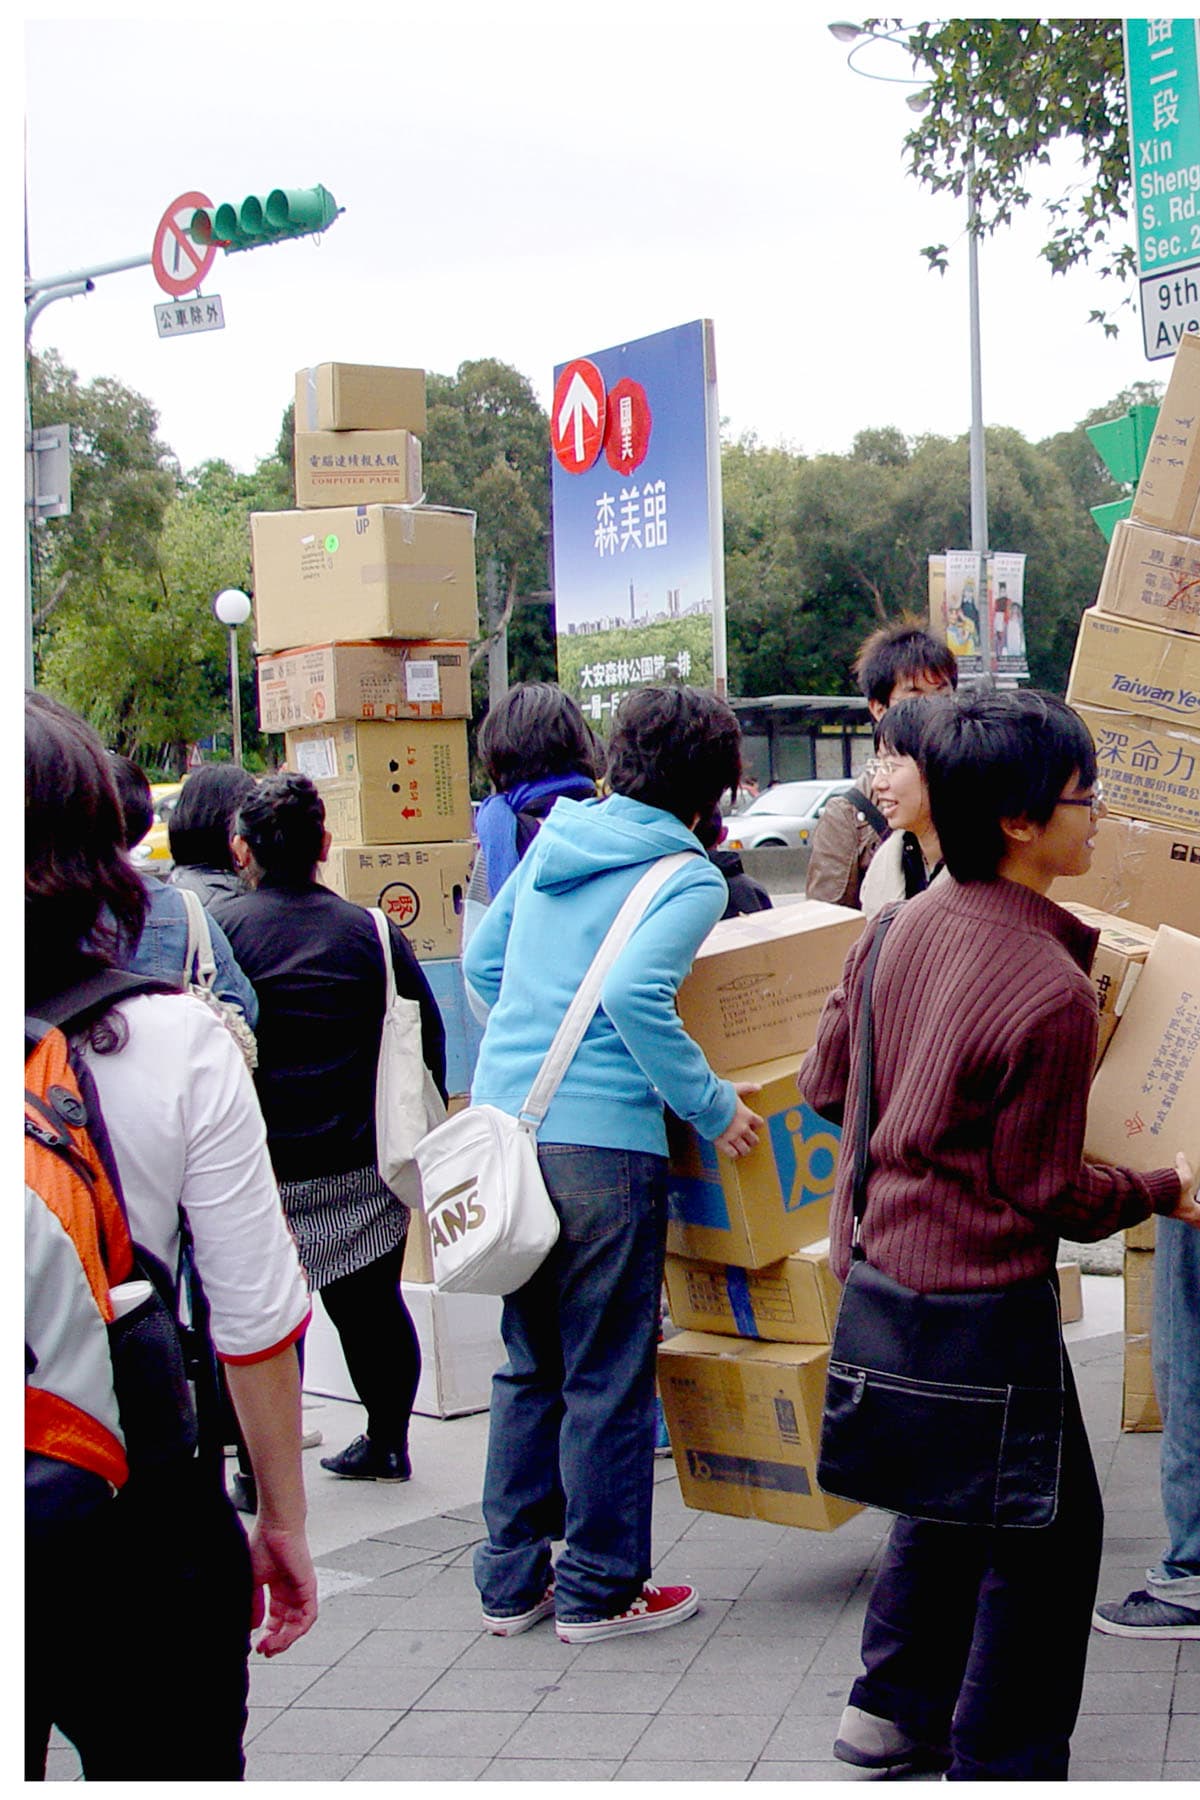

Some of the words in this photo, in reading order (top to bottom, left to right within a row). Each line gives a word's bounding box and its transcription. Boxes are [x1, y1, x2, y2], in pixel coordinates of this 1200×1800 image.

[1139, 140, 1173, 168] Xin
[1142, 205, 1163, 230] S.
[1158, 277, 1198, 312] 9th
[161, 303, 218, 329] 公車除外
[311, 477, 365, 485] COMPUTER
[356, 519, 370, 535] UP
[580, 651, 692, 689] 大安森林公園第一排
[1110, 673, 1175, 702] Taiwan
[387, 895, 413, 920] 賢
[430, 1190, 487, 1258] ANS
